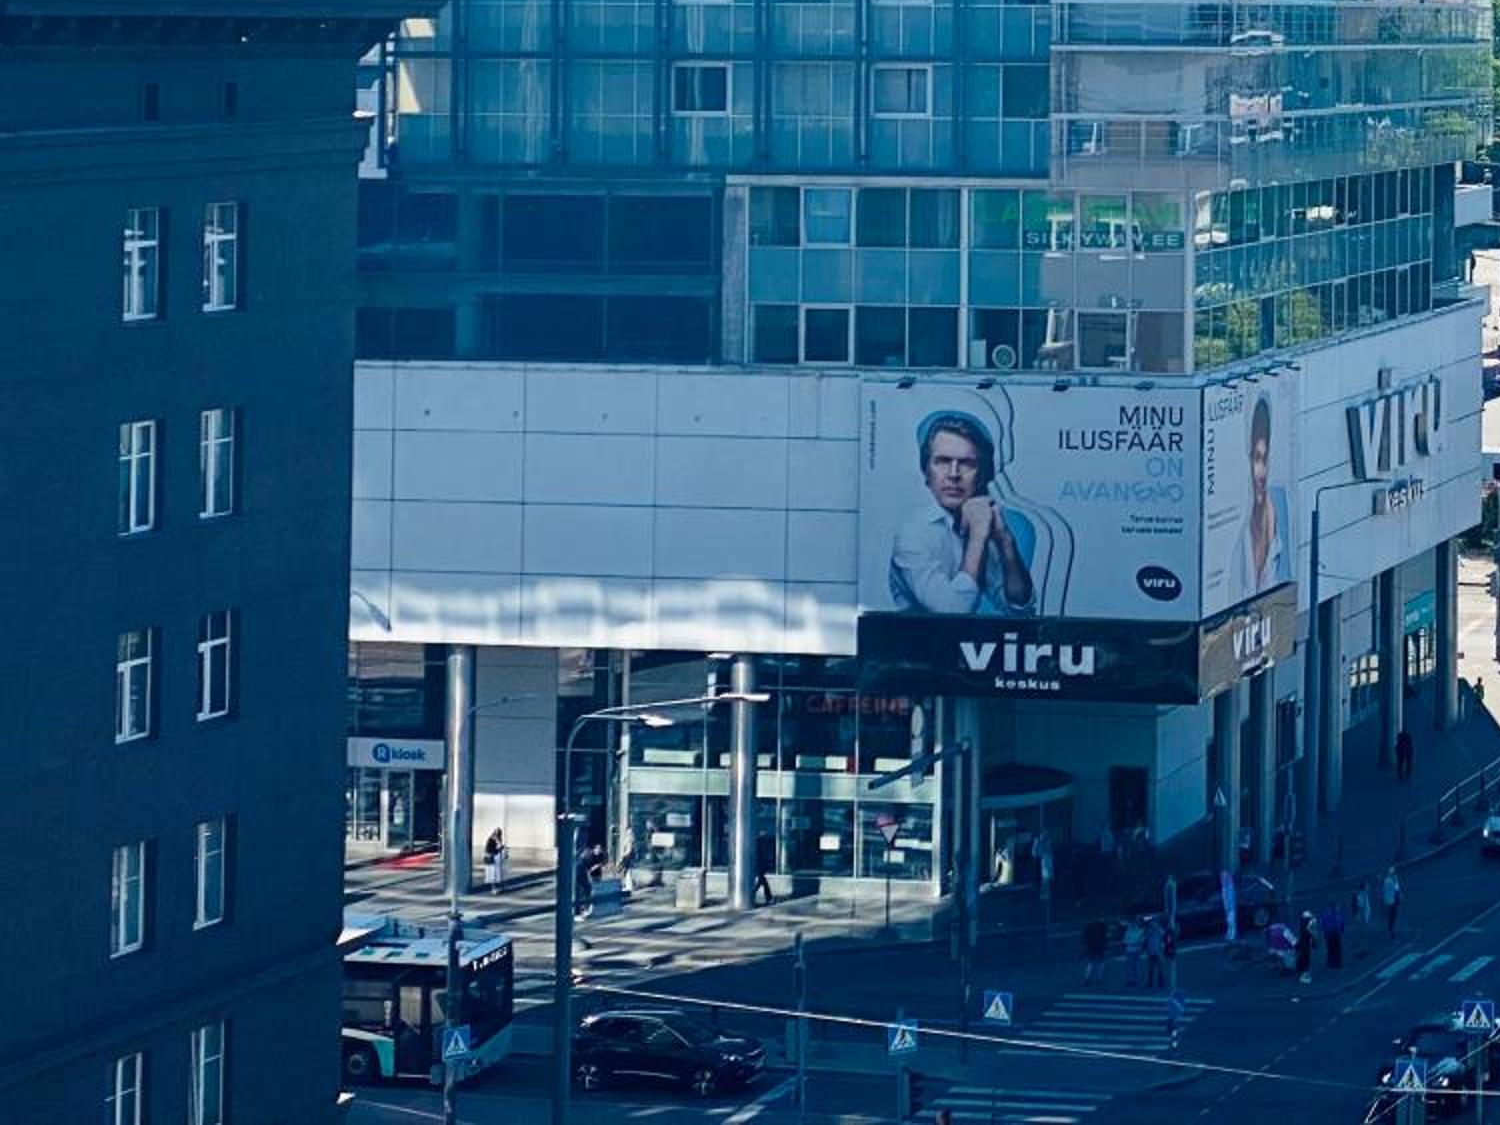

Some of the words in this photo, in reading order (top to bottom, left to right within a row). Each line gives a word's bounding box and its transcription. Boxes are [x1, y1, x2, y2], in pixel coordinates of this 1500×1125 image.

[1119, 405, 1184, 427] MINU
[1059, 425, 1184, 452] ILUSFÄÄR
[1146, 457, 1184, 477] ON
[1143, 578, 1176, 588] viru
[1232, 615, 1271, 660] viru
[959, 631, 1095, 676] viru
[994, 676, 1061, 691] keskus
